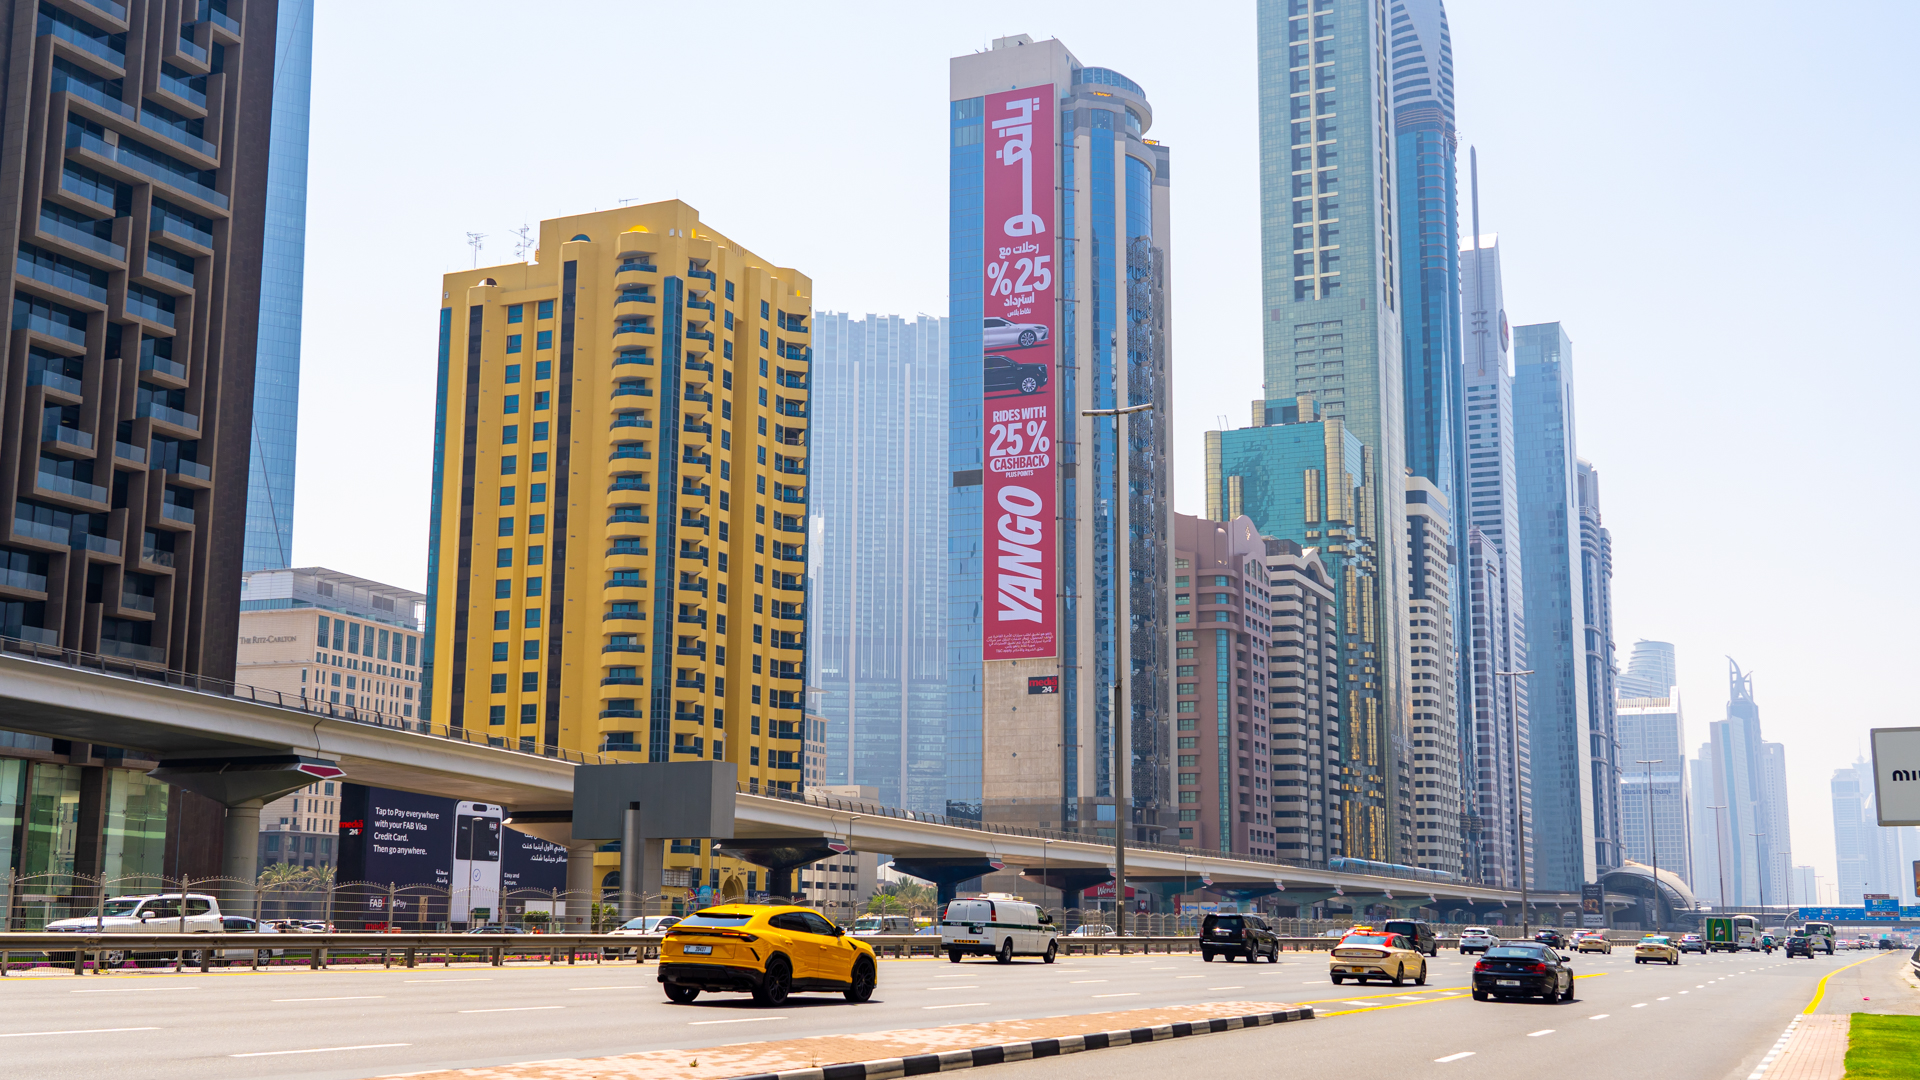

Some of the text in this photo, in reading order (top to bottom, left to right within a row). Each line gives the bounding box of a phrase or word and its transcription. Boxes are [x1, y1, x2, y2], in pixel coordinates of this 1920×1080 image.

[992, 97, 1045, 237] يانغو
[999, 241, 1039, 259] رحلات مع
[1003, 292, 1035, 308] استرداد
[992, 406, 1047, 423] RIDES WITH
[989, 420, 1050, 457] 25%
[993, 454, 1046, 471] CASHBACK
[1005, 469, 1034, 478] PLUS POINTS
[997, 485, 1043, 624] YANGO
[239, 636, 252, 645] THE
[1028, 677, 1058, 687] media
[1892, 769, 1920, 781] mi
[375, 806, 440, 820] Tap to Pay everywhere
[339, 820, 363, 828] media
[374, 820, 428, 831] with your FAB Visa
[373, 831, 409, 842] Credit Card.
[373, 844, 428, 856] Then go anywhere.
[370, 899, 406, 909] FAB Pay
